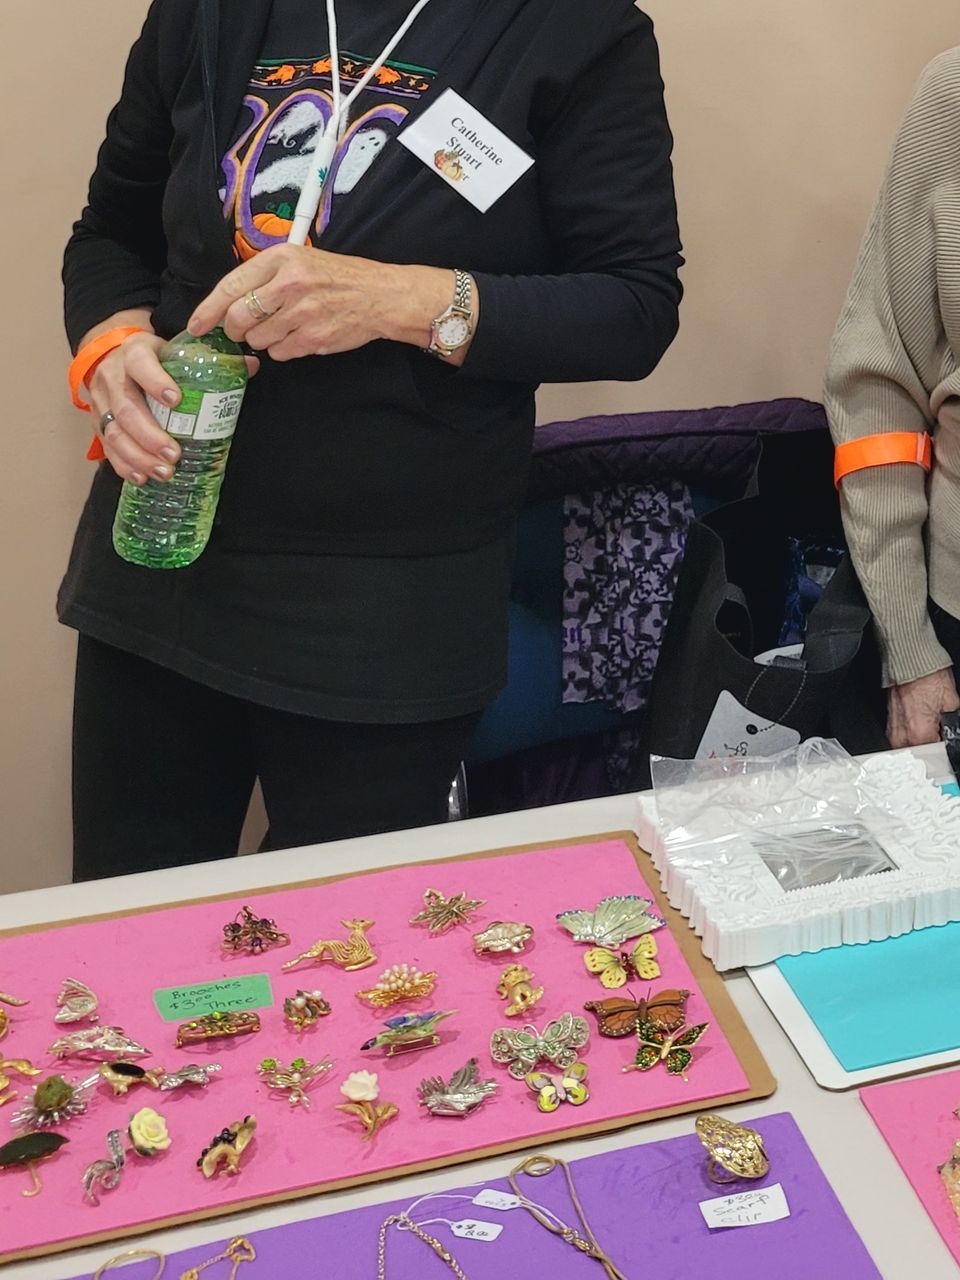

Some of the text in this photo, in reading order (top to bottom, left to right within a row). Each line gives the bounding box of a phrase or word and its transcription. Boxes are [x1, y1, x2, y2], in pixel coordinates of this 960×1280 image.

[446, 136, 483, 170] Stuart
[451, 117, 504, 166] Catherine
[171, 981, 241, 1000] Brooches
[203, 996, 258, 1010] Three
